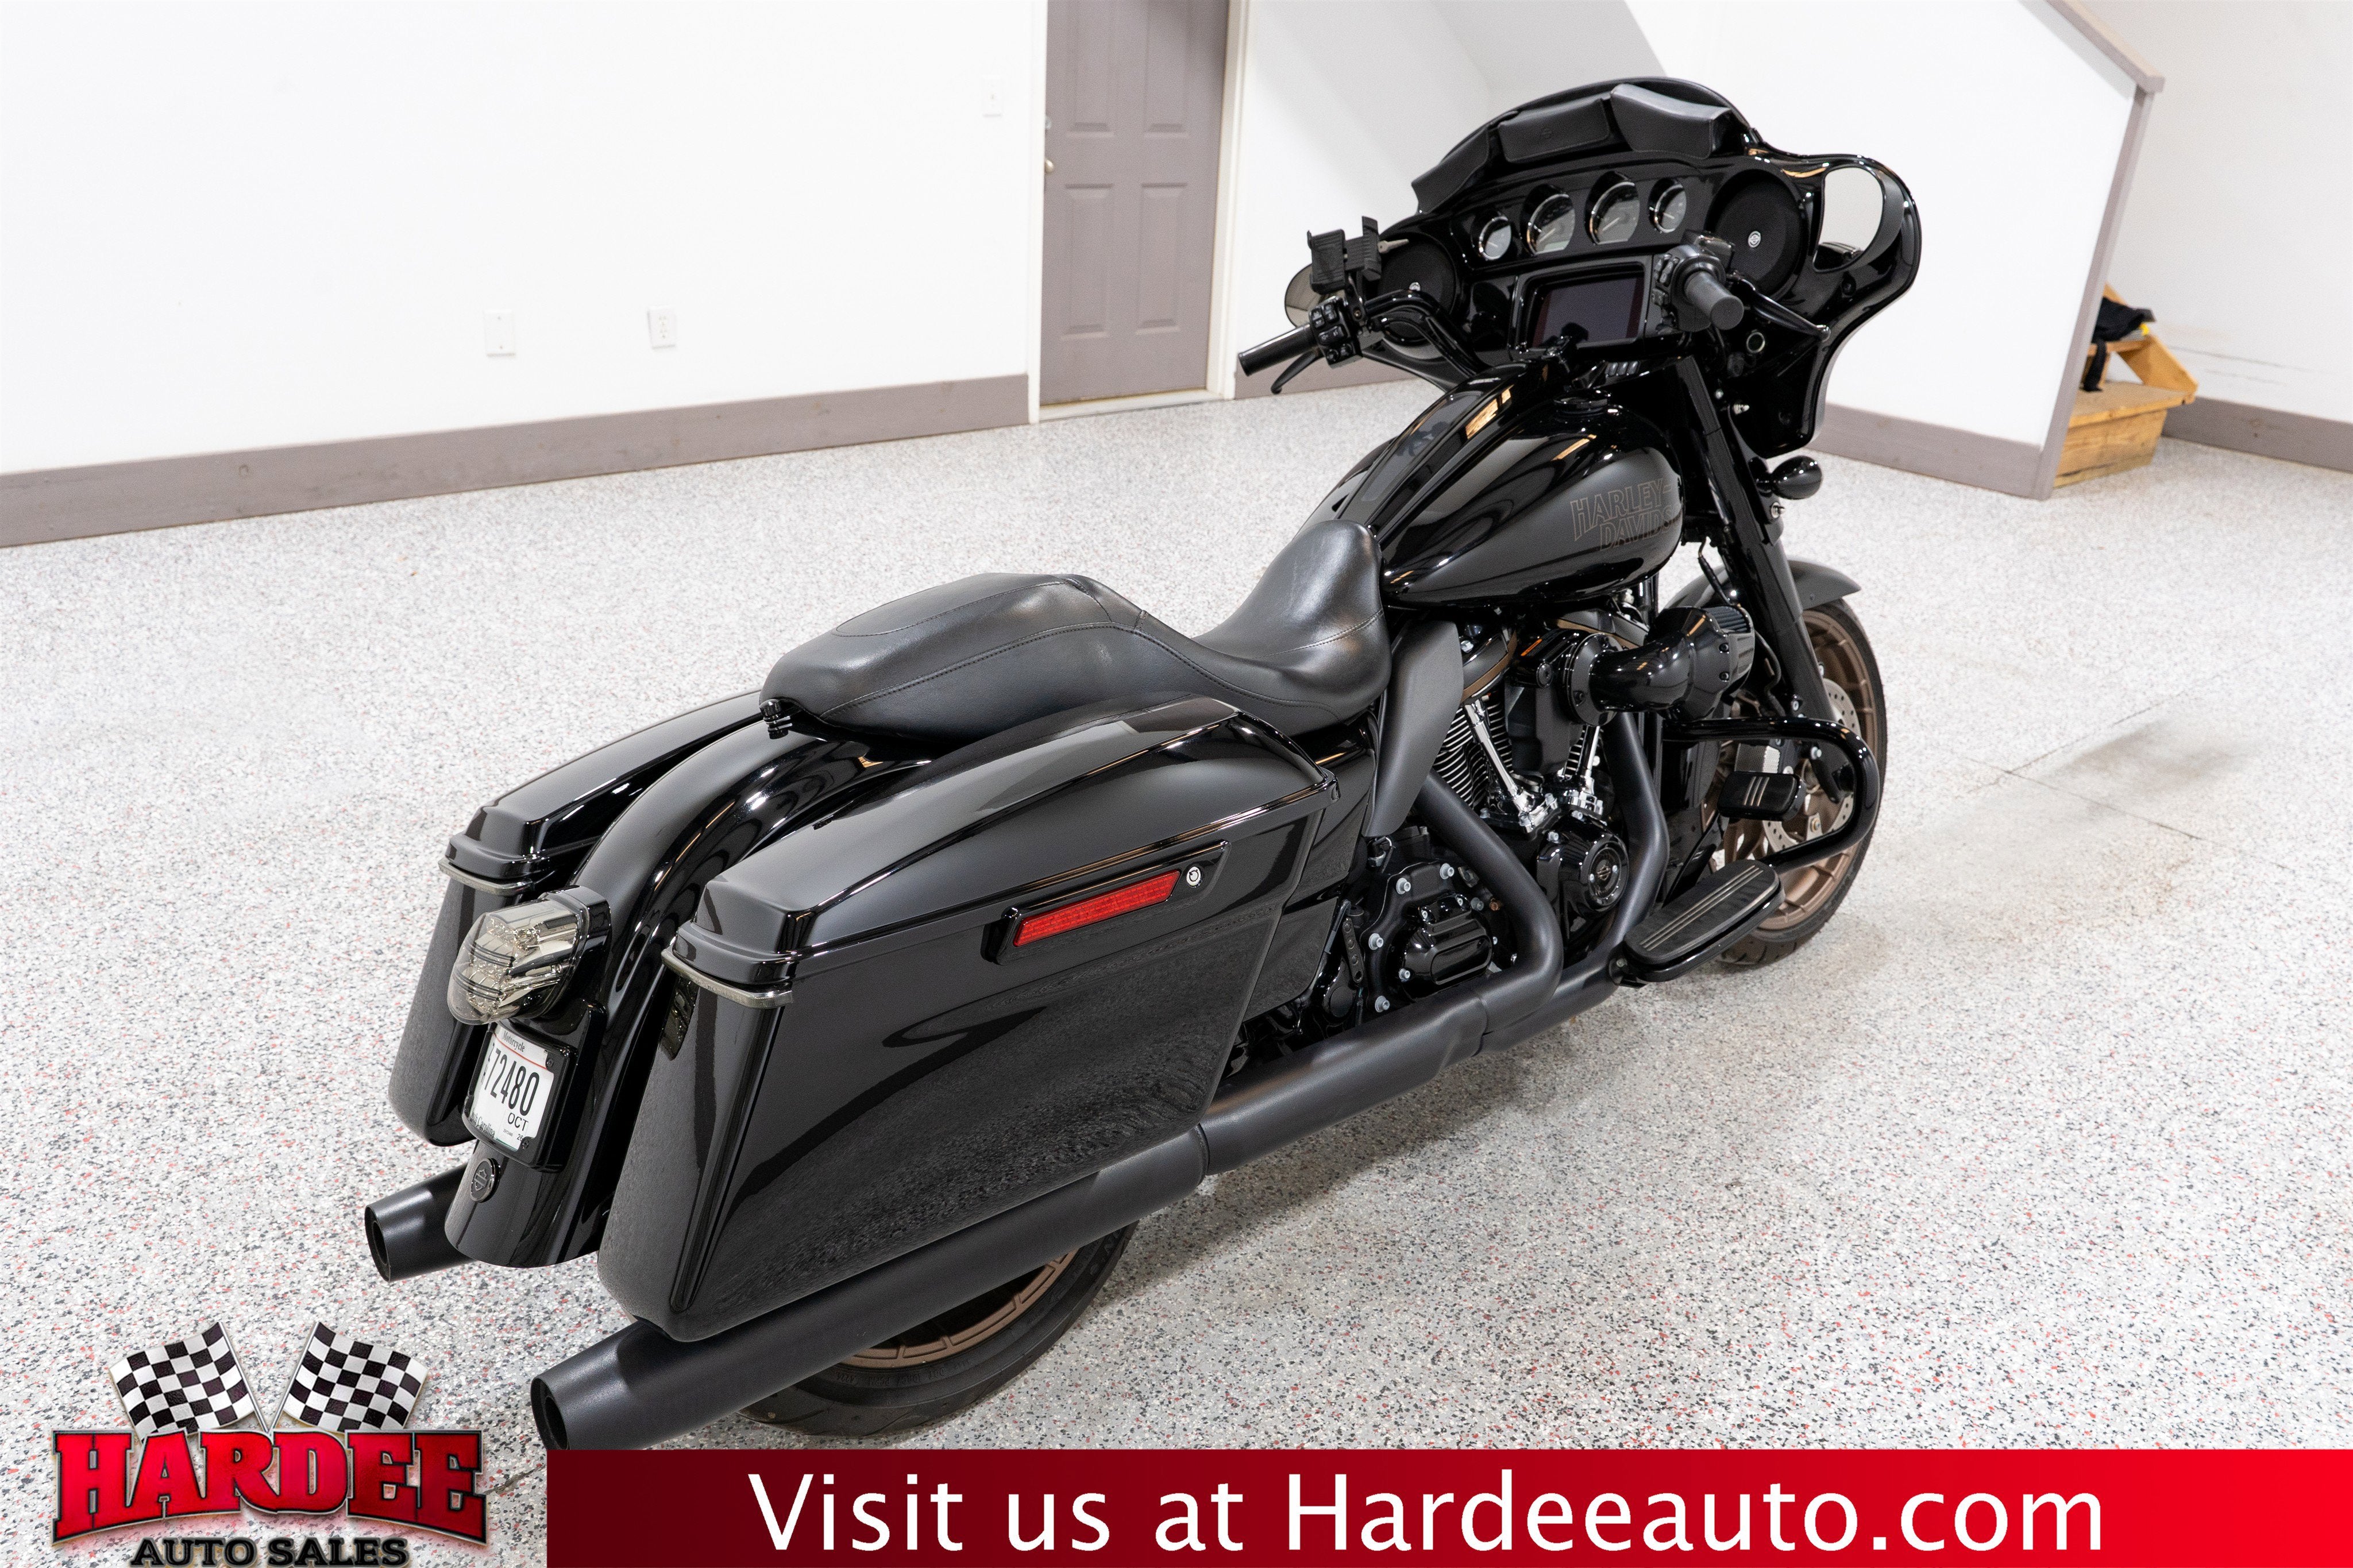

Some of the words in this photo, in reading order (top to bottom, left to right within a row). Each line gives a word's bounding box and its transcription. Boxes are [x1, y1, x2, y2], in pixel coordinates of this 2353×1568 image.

[503, 1030, 525, 1053] Motorcycle
[484, 1048, 539, 1117] 72480
[507, 1113, 529, 1131] OCT
